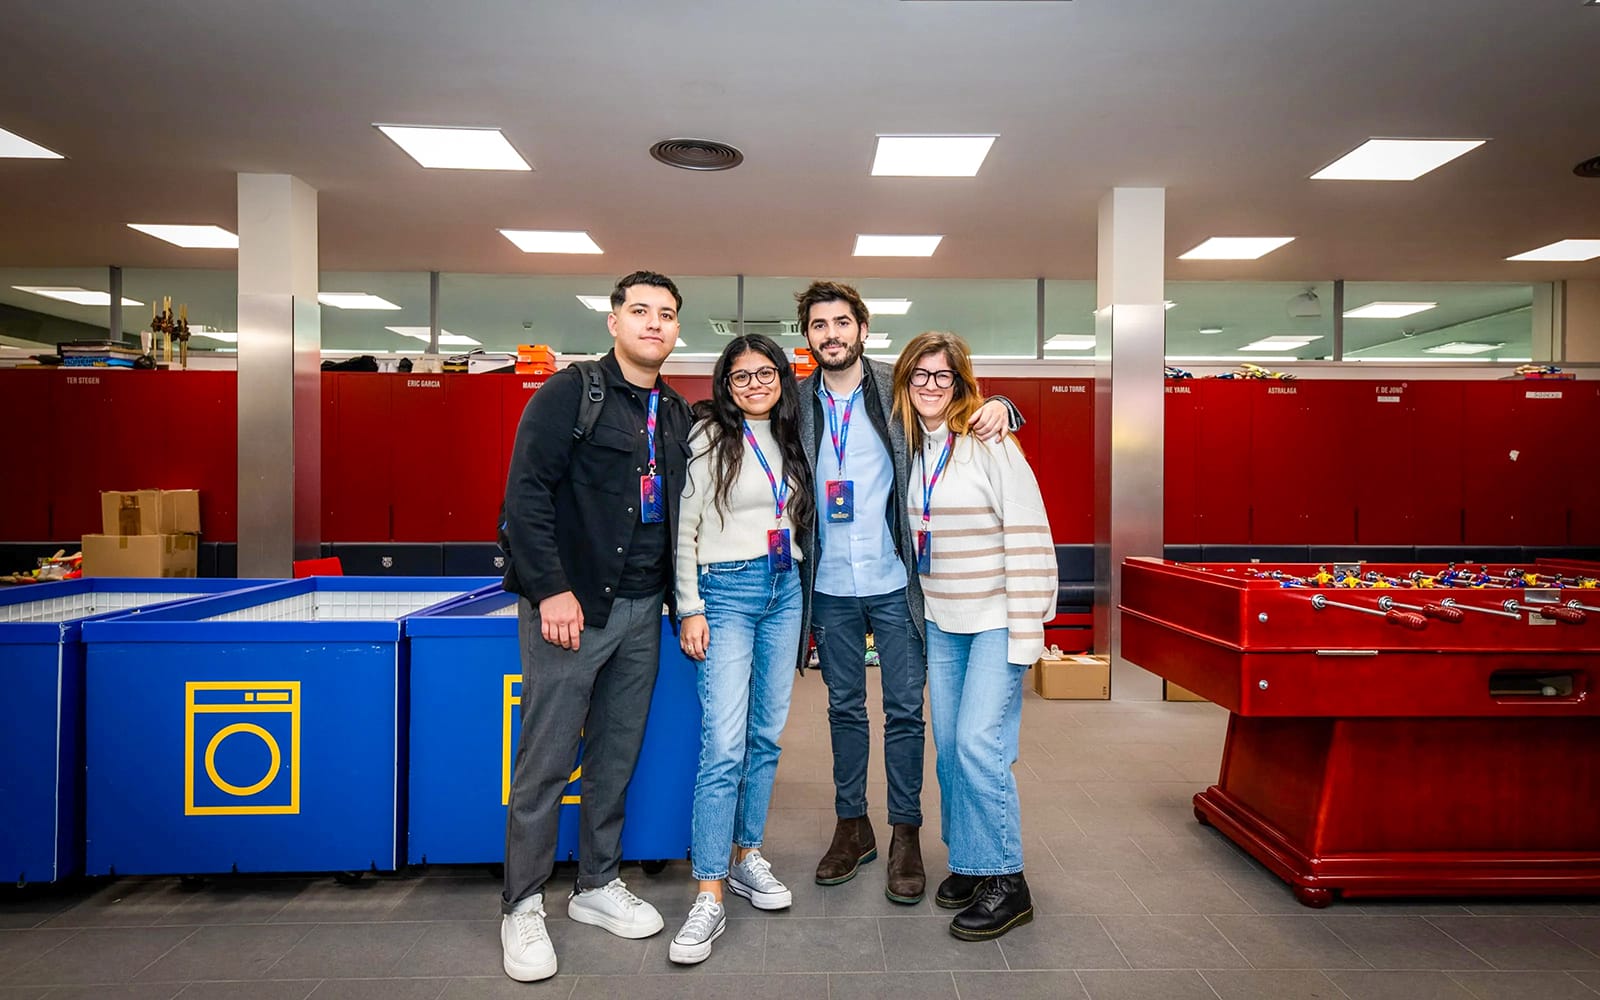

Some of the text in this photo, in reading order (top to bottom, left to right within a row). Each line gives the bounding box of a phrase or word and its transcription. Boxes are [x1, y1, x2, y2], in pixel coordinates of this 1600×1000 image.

[66, 376, 100, 385] TER STEGEN
[420, 380, 441, 388] GARCIA
[1051, 385, 1086, 393] PABLO TORRE
[1174, 386, 1191, 394] YAMAL
[1389, 386, 1404, 394] JONG
